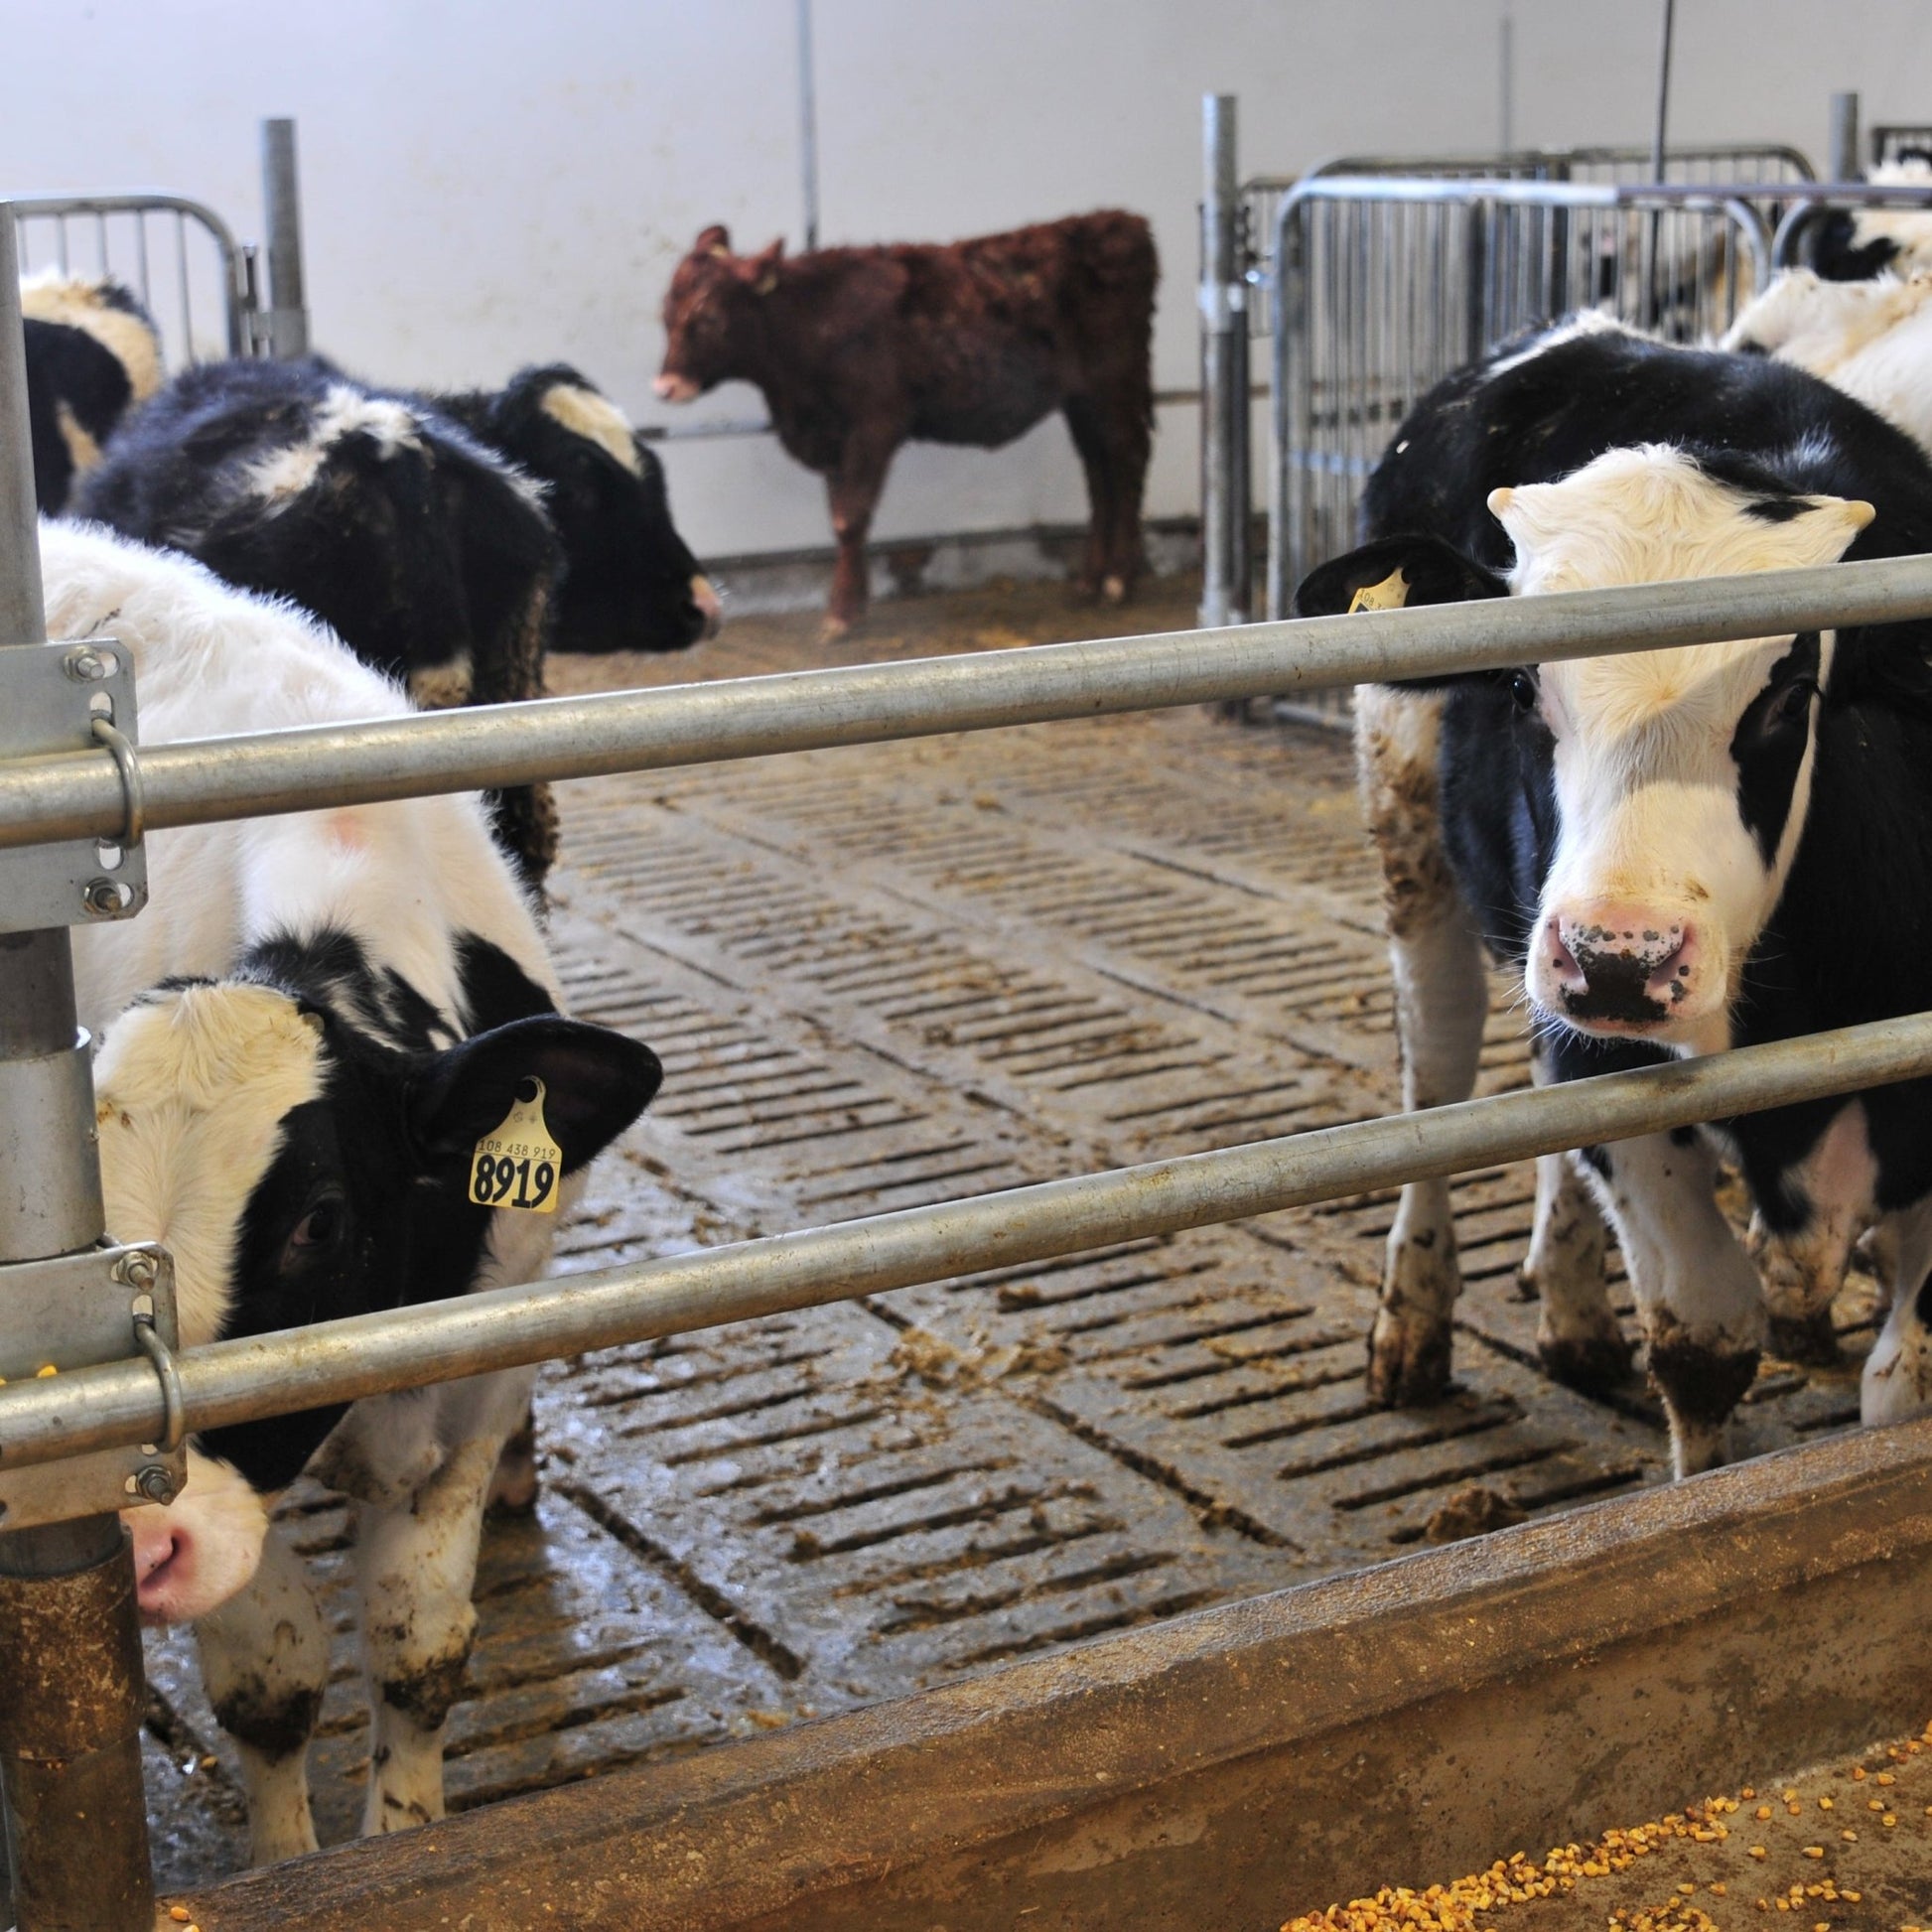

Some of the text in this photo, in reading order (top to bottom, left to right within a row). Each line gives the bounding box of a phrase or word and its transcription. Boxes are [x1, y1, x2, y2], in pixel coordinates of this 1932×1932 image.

[479, 1140, 556, 1160] 108 438 919
[474, 1154, 554, 1209] 8919
